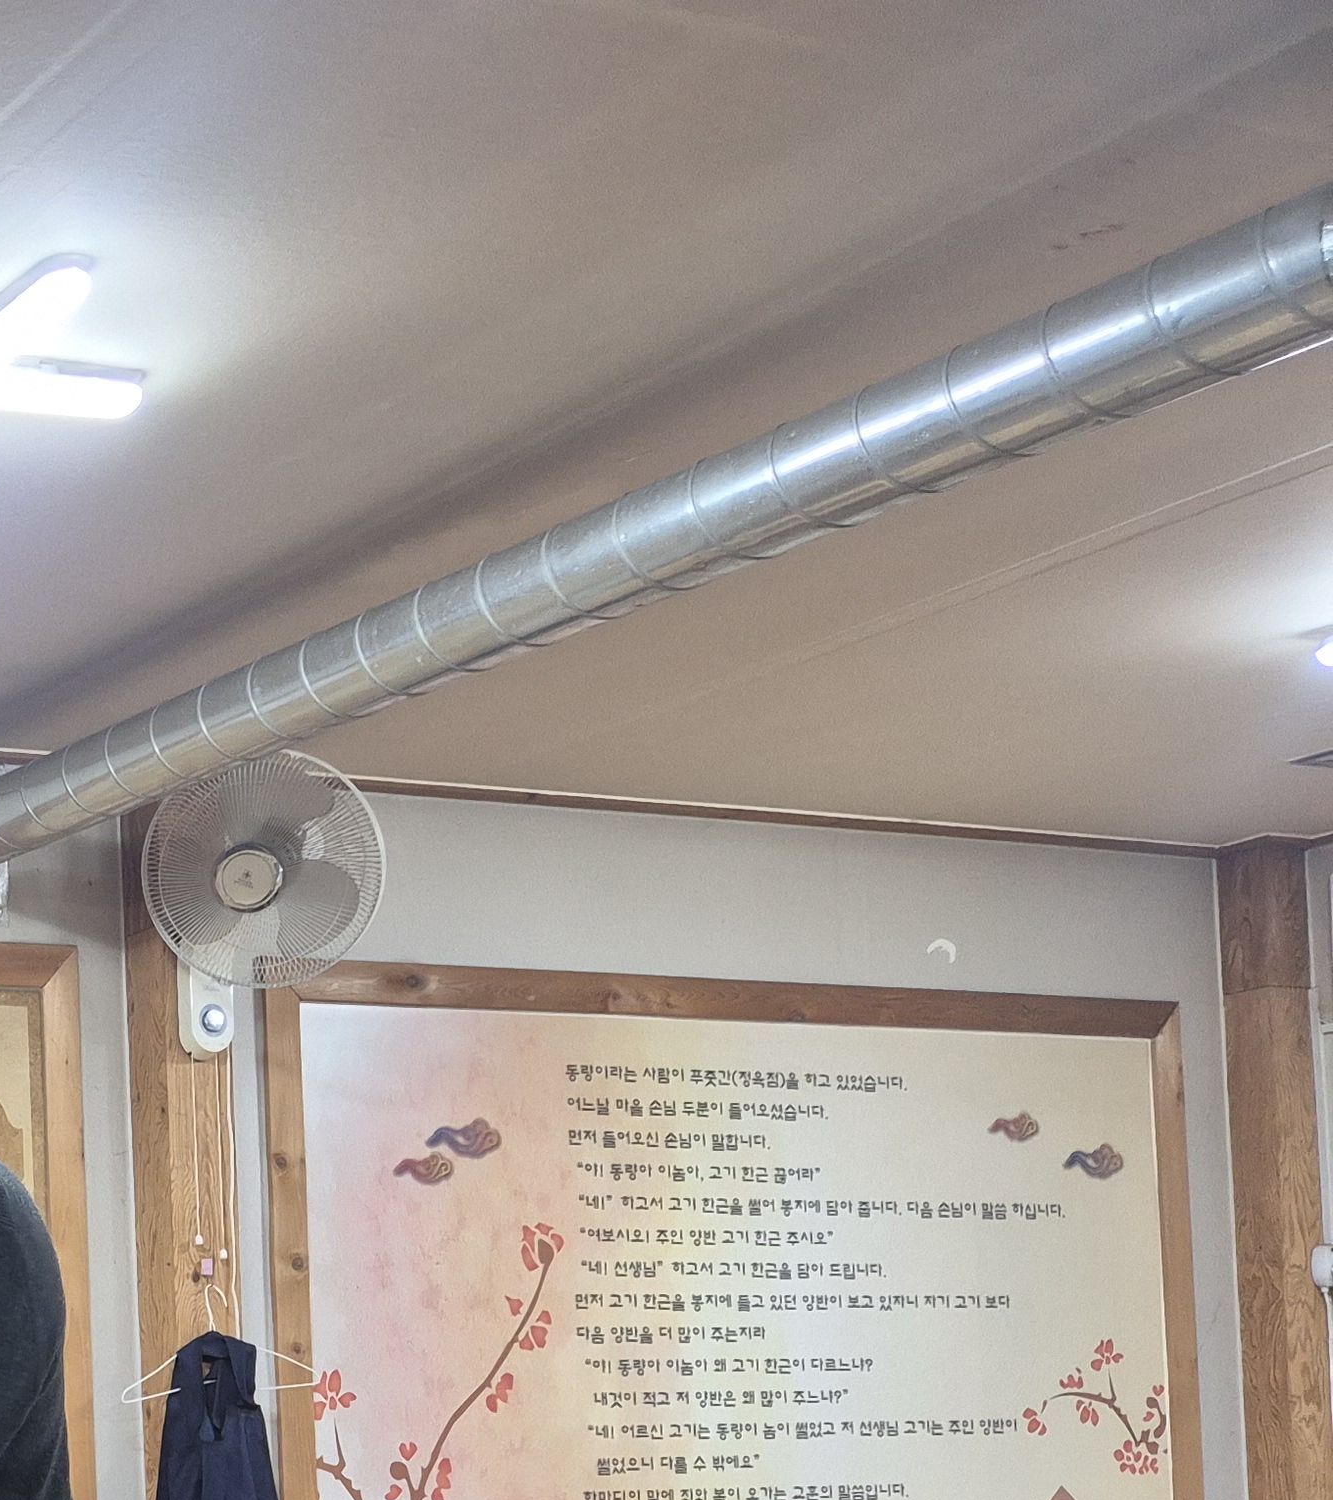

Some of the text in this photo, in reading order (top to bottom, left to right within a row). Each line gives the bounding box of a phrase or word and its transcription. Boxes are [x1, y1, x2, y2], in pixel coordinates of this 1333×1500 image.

[642, 1066, 685, 1085] 사람이
[803, 1072, 832, 1088] 하고
[567, 1096, 610, 1117] 어느날
[615, 1097, 644, 1118] 마을
[648, 1099, 677, 1117] 손님
[681, 1100, 724, 1119] 두분이
[567, 1129, 598, 1146] 먼저
[601, 1130, 660, 1149] 들어오신
[663, 1131, 707, 1150] 손님이
[708, 1165, 737, 1180] 고기
[740, 1166, 769, 1184] 한근
[620, 1195, 663, 1211] 하고서
[667, 1196, 697, 1212] 고기
[701, 1197, 744, 1216] 한근을
[747, 1198, 776, 1217] 썰어
[779, 1198, 821, 1218] 봉지에
[825, 1199, 853, 1217] 담아
[906, 1200, 934, 1219] 다음
[937, 1201, 977, 1219] 손님이
[980, 1201, 1008, 1221] 말씀
[655, 1228, 684, 1246] 주인
[689, 1229, 717, 1247] 양반
[721, 1229, 750, 1244] 고기
[753, 1229, 782, 1247] 한근
[670, 1261, 714, 1276] 하고서
[718, 1262, 746, 1276] 고기
[750, 1261, 793, 1281] 한근을
[796, 1262, 824, 1280] 담아
[574, 1293, 1011, 1313] 먼저 고기 한근을 봉지에 들고 있던 양반이 보고 있자니 자기 고기 보다
[575, 1325, 766, 1345] 다음 양반을 더 많이 주는지라
[665, 1358, 708, 1377] 이놈아
[713, 1358, 727, 1373] 왜
[731, 1358, 760, 1373] 고기
[763, 1357, 806, 1375] 한근이
[593, 1391, 637, 1409] 내것이
[641, 1391, 671, 1408] 적고
[675, 1390, 690, 1405] 저
[695, 1389, 737, 1409] 양반은
[741, 1390, 756, 1405] 왜
[759, 1389, 788, 1408] 많이
[620, 1423, 664, 1441] 어르신
[668, 1422, 711, 1440] 고기는
[762, 1422, 790, 1440] 놈이
[795, 1421, 837, 1440] 썰었고
[840, 1420, 855, 1435] 저
[859, 1420, 900, 1438] 선생님
[903, 1419, 944, 1437] 고기는
[948, 1419, 975, 1436] 주인
[979, 1417, 1018, 1436] 양반이
[596, 1456, 655, 1477] 썰었으니
[659, 1455, 688, 1475] 다를
[692, 1455, 707, 1472] 수
